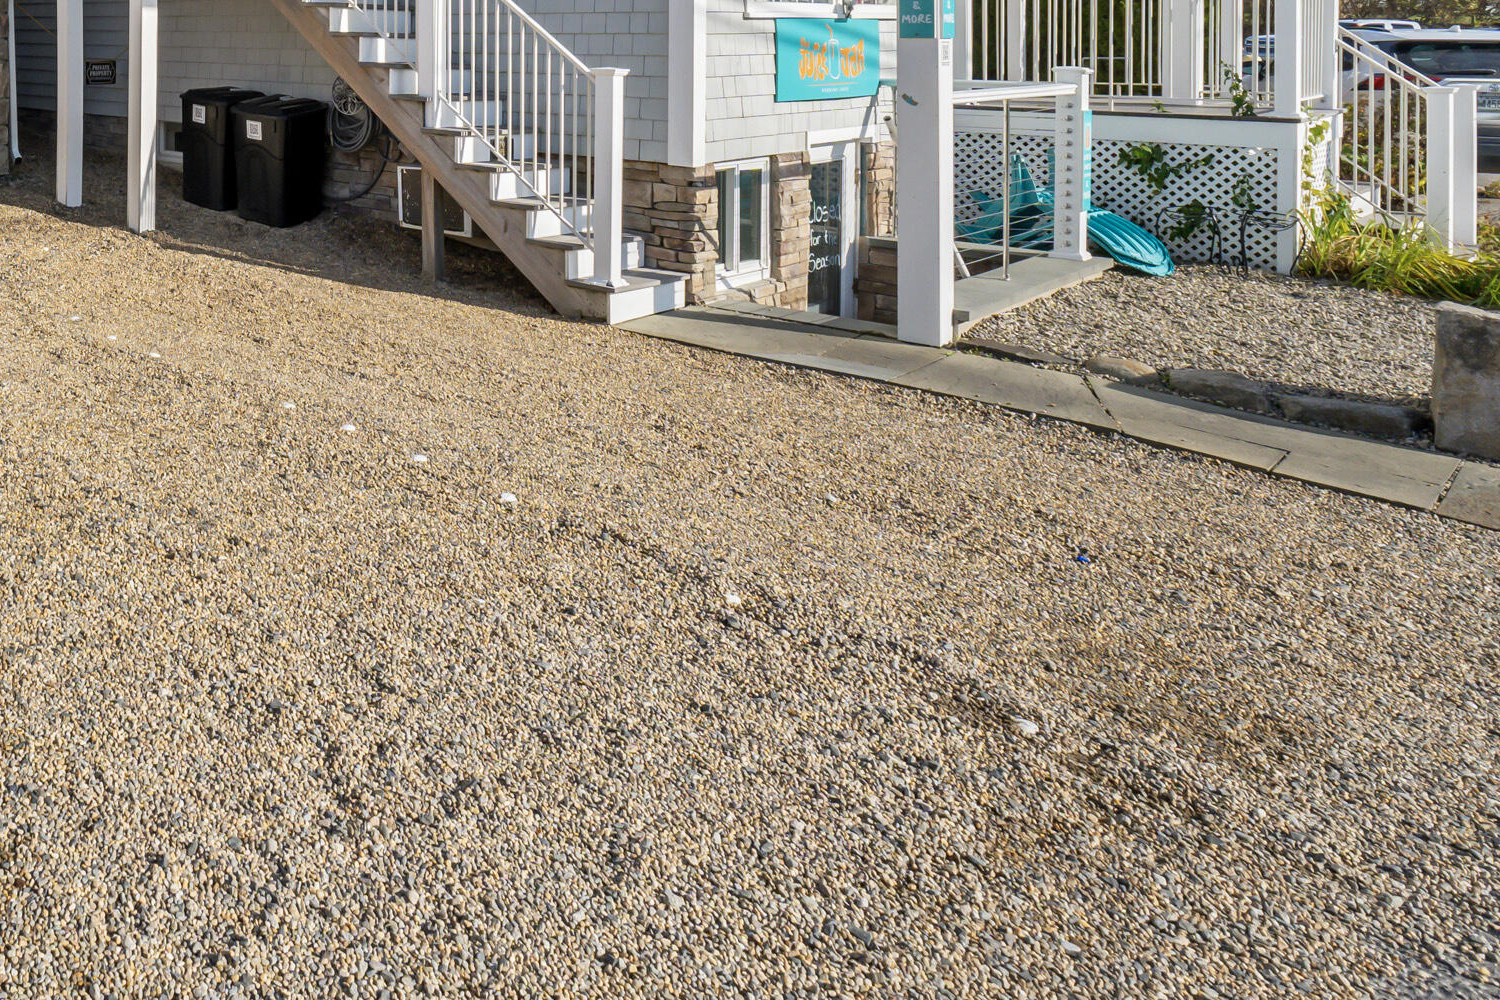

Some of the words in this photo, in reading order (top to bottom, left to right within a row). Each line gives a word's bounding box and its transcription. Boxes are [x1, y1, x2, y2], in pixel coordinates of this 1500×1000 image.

[912, 0, 921, 10] &
[901, 13, 933, 24] MORE
[807, 253, 841, 273] Season
